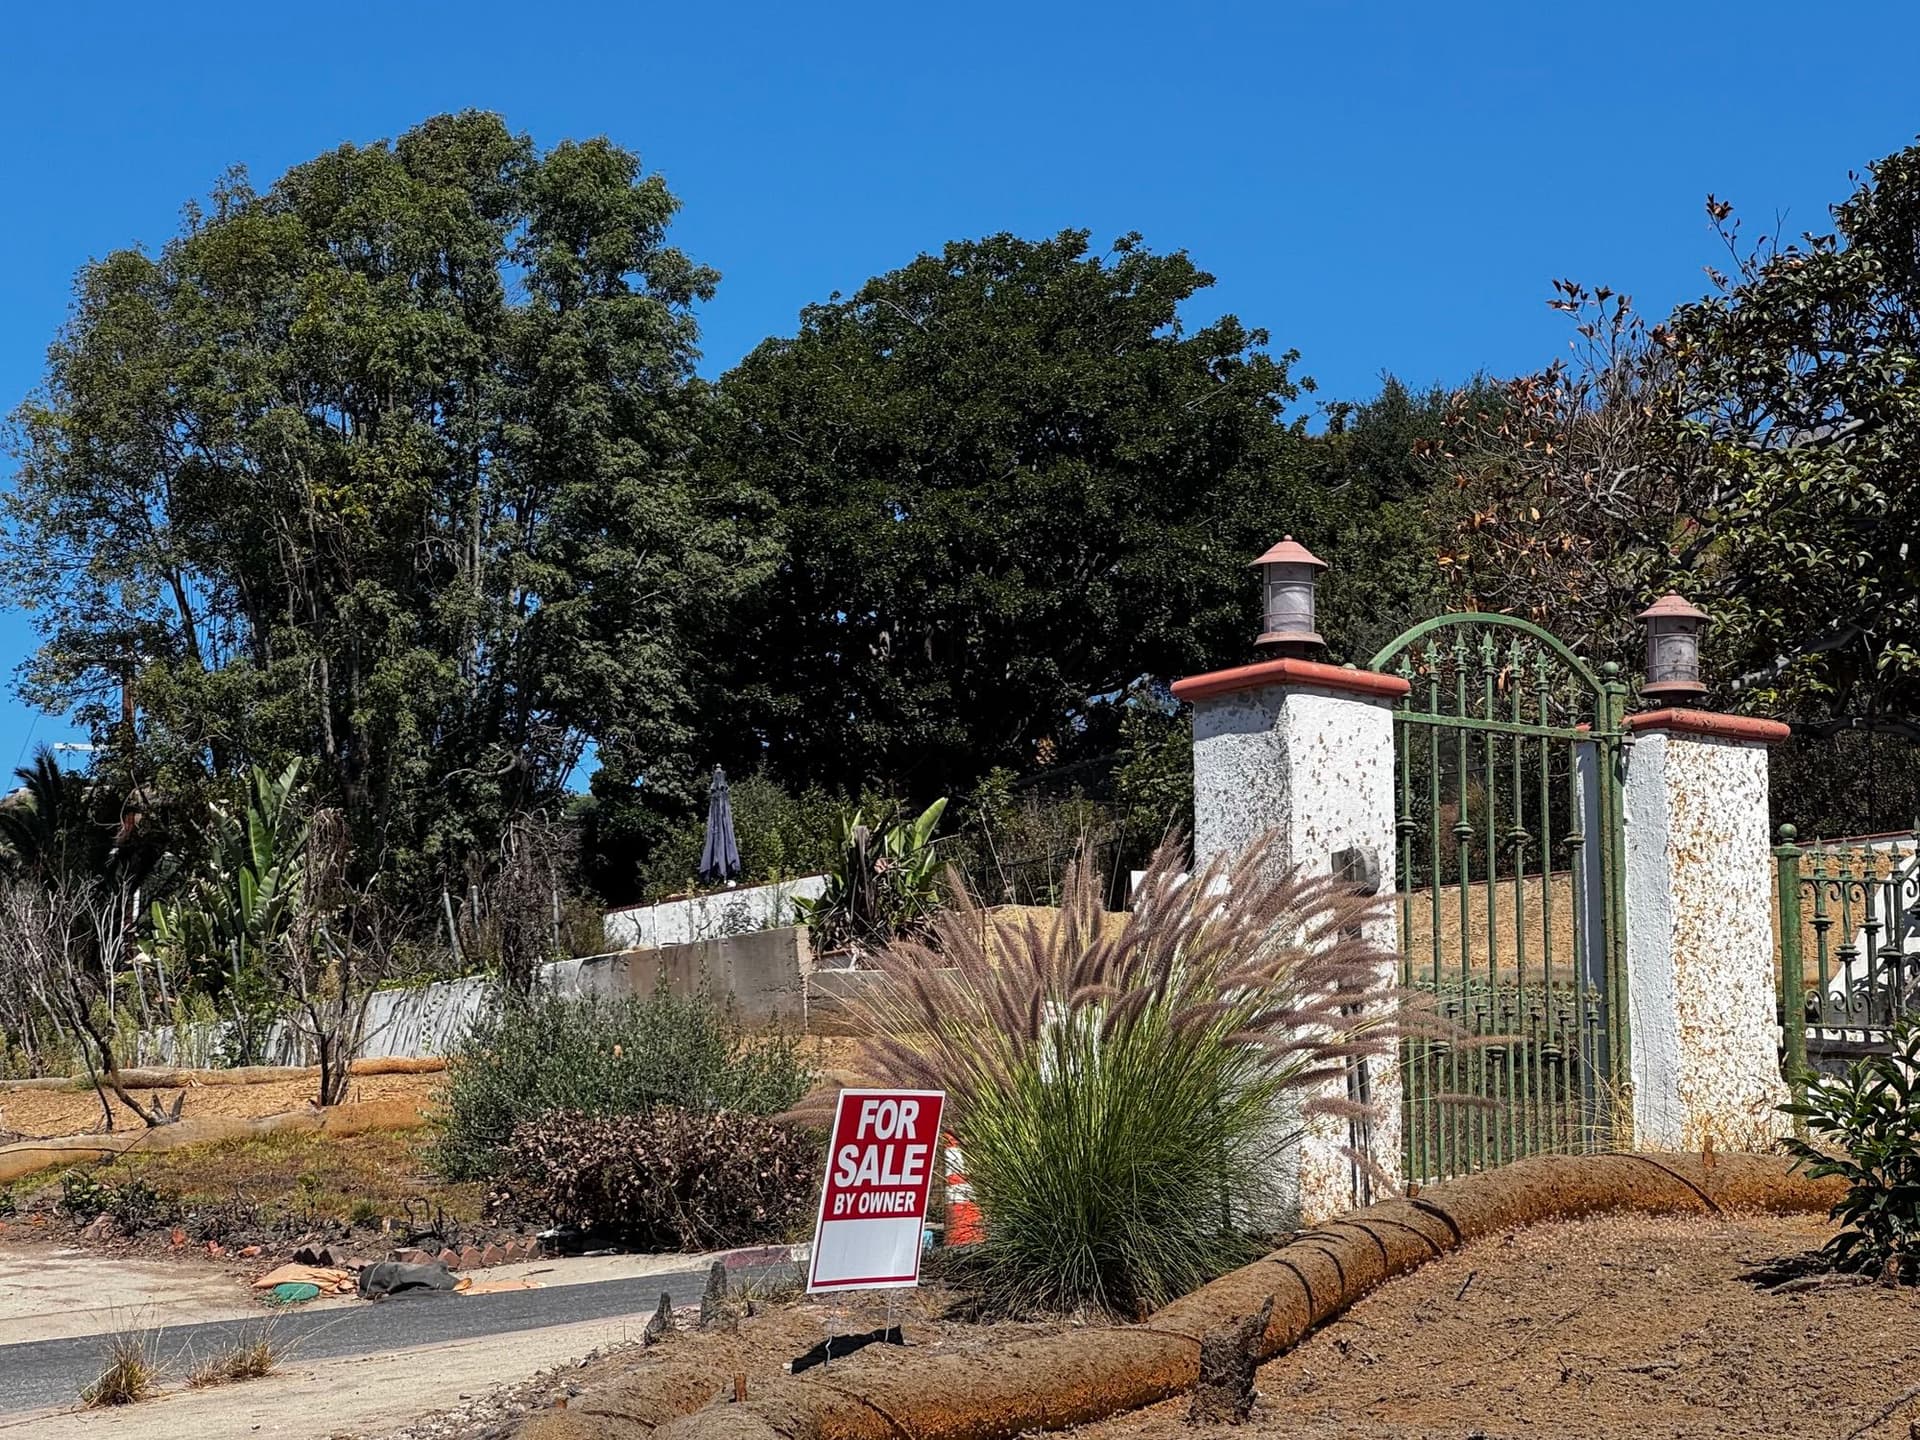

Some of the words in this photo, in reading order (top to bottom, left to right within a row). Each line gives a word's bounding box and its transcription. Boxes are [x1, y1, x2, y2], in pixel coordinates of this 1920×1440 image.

[857, 1099, 919, 1140] FOR
[834, 1144, 928, 1187] SALE
[833, 1193, 856, 1215] BY
[858, 1191, 916, 1213] OWNER
